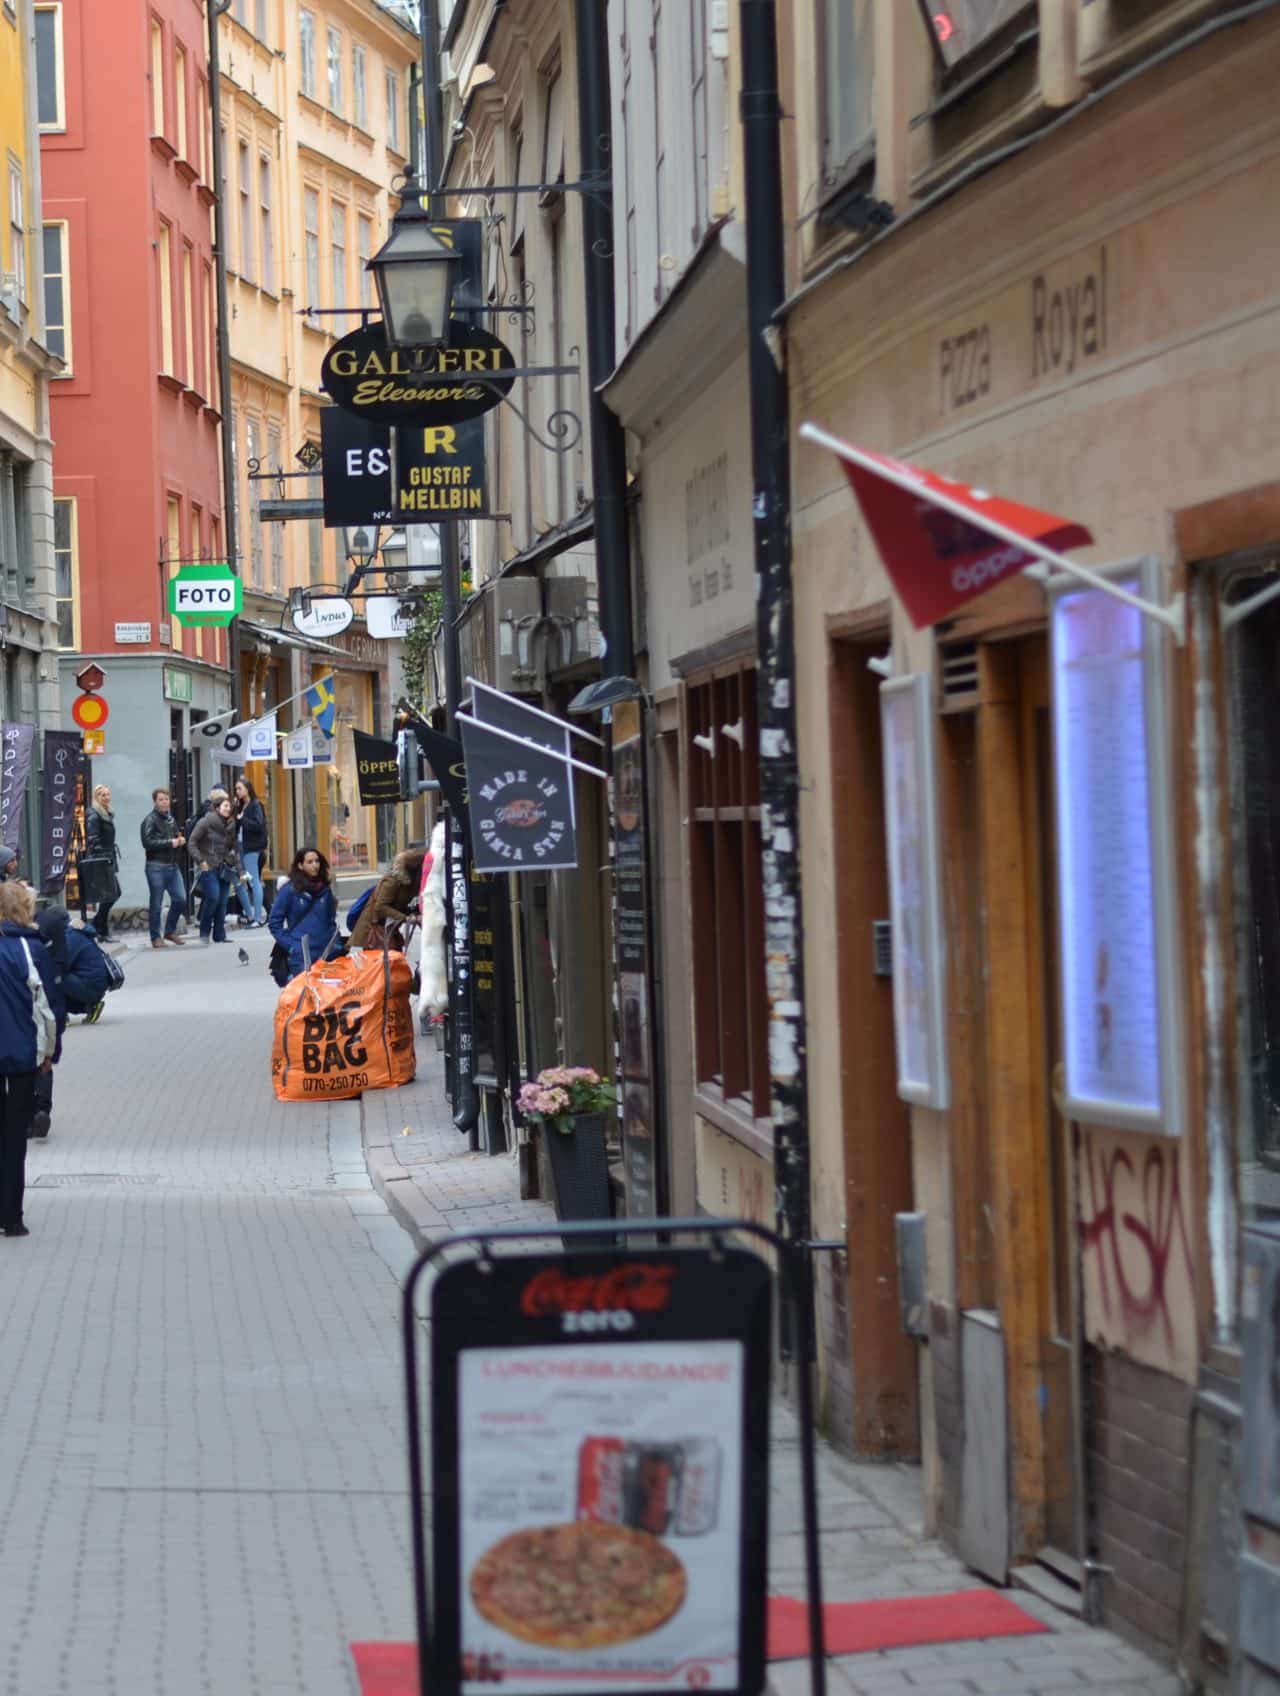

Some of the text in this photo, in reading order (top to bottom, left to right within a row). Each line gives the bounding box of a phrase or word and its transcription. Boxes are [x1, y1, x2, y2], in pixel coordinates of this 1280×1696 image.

[939, 245, 1107, 417] Pizza Royal
[329, 347, 505, 376] GALLERI
[352, 379, 486, 405] Eleonora
[345, 447, 392, 477] E&
[409, 466, 472, 486] GUSTAF
[400, 488, 482, 511] MELLBIN
[178, 588, 231, 603] FOTO
[479, 769, 529, 801] MADE
[536, 777, 559, 798] IN
[52, 773, 67, 874] EDBLAD
[479, 819, 565, 861] GAMLA STAN
[303, 1001, 364, 1043] BIG
[302, 1035, 369, 1074] BAG
[561, 1308, 636, 1333] zero
